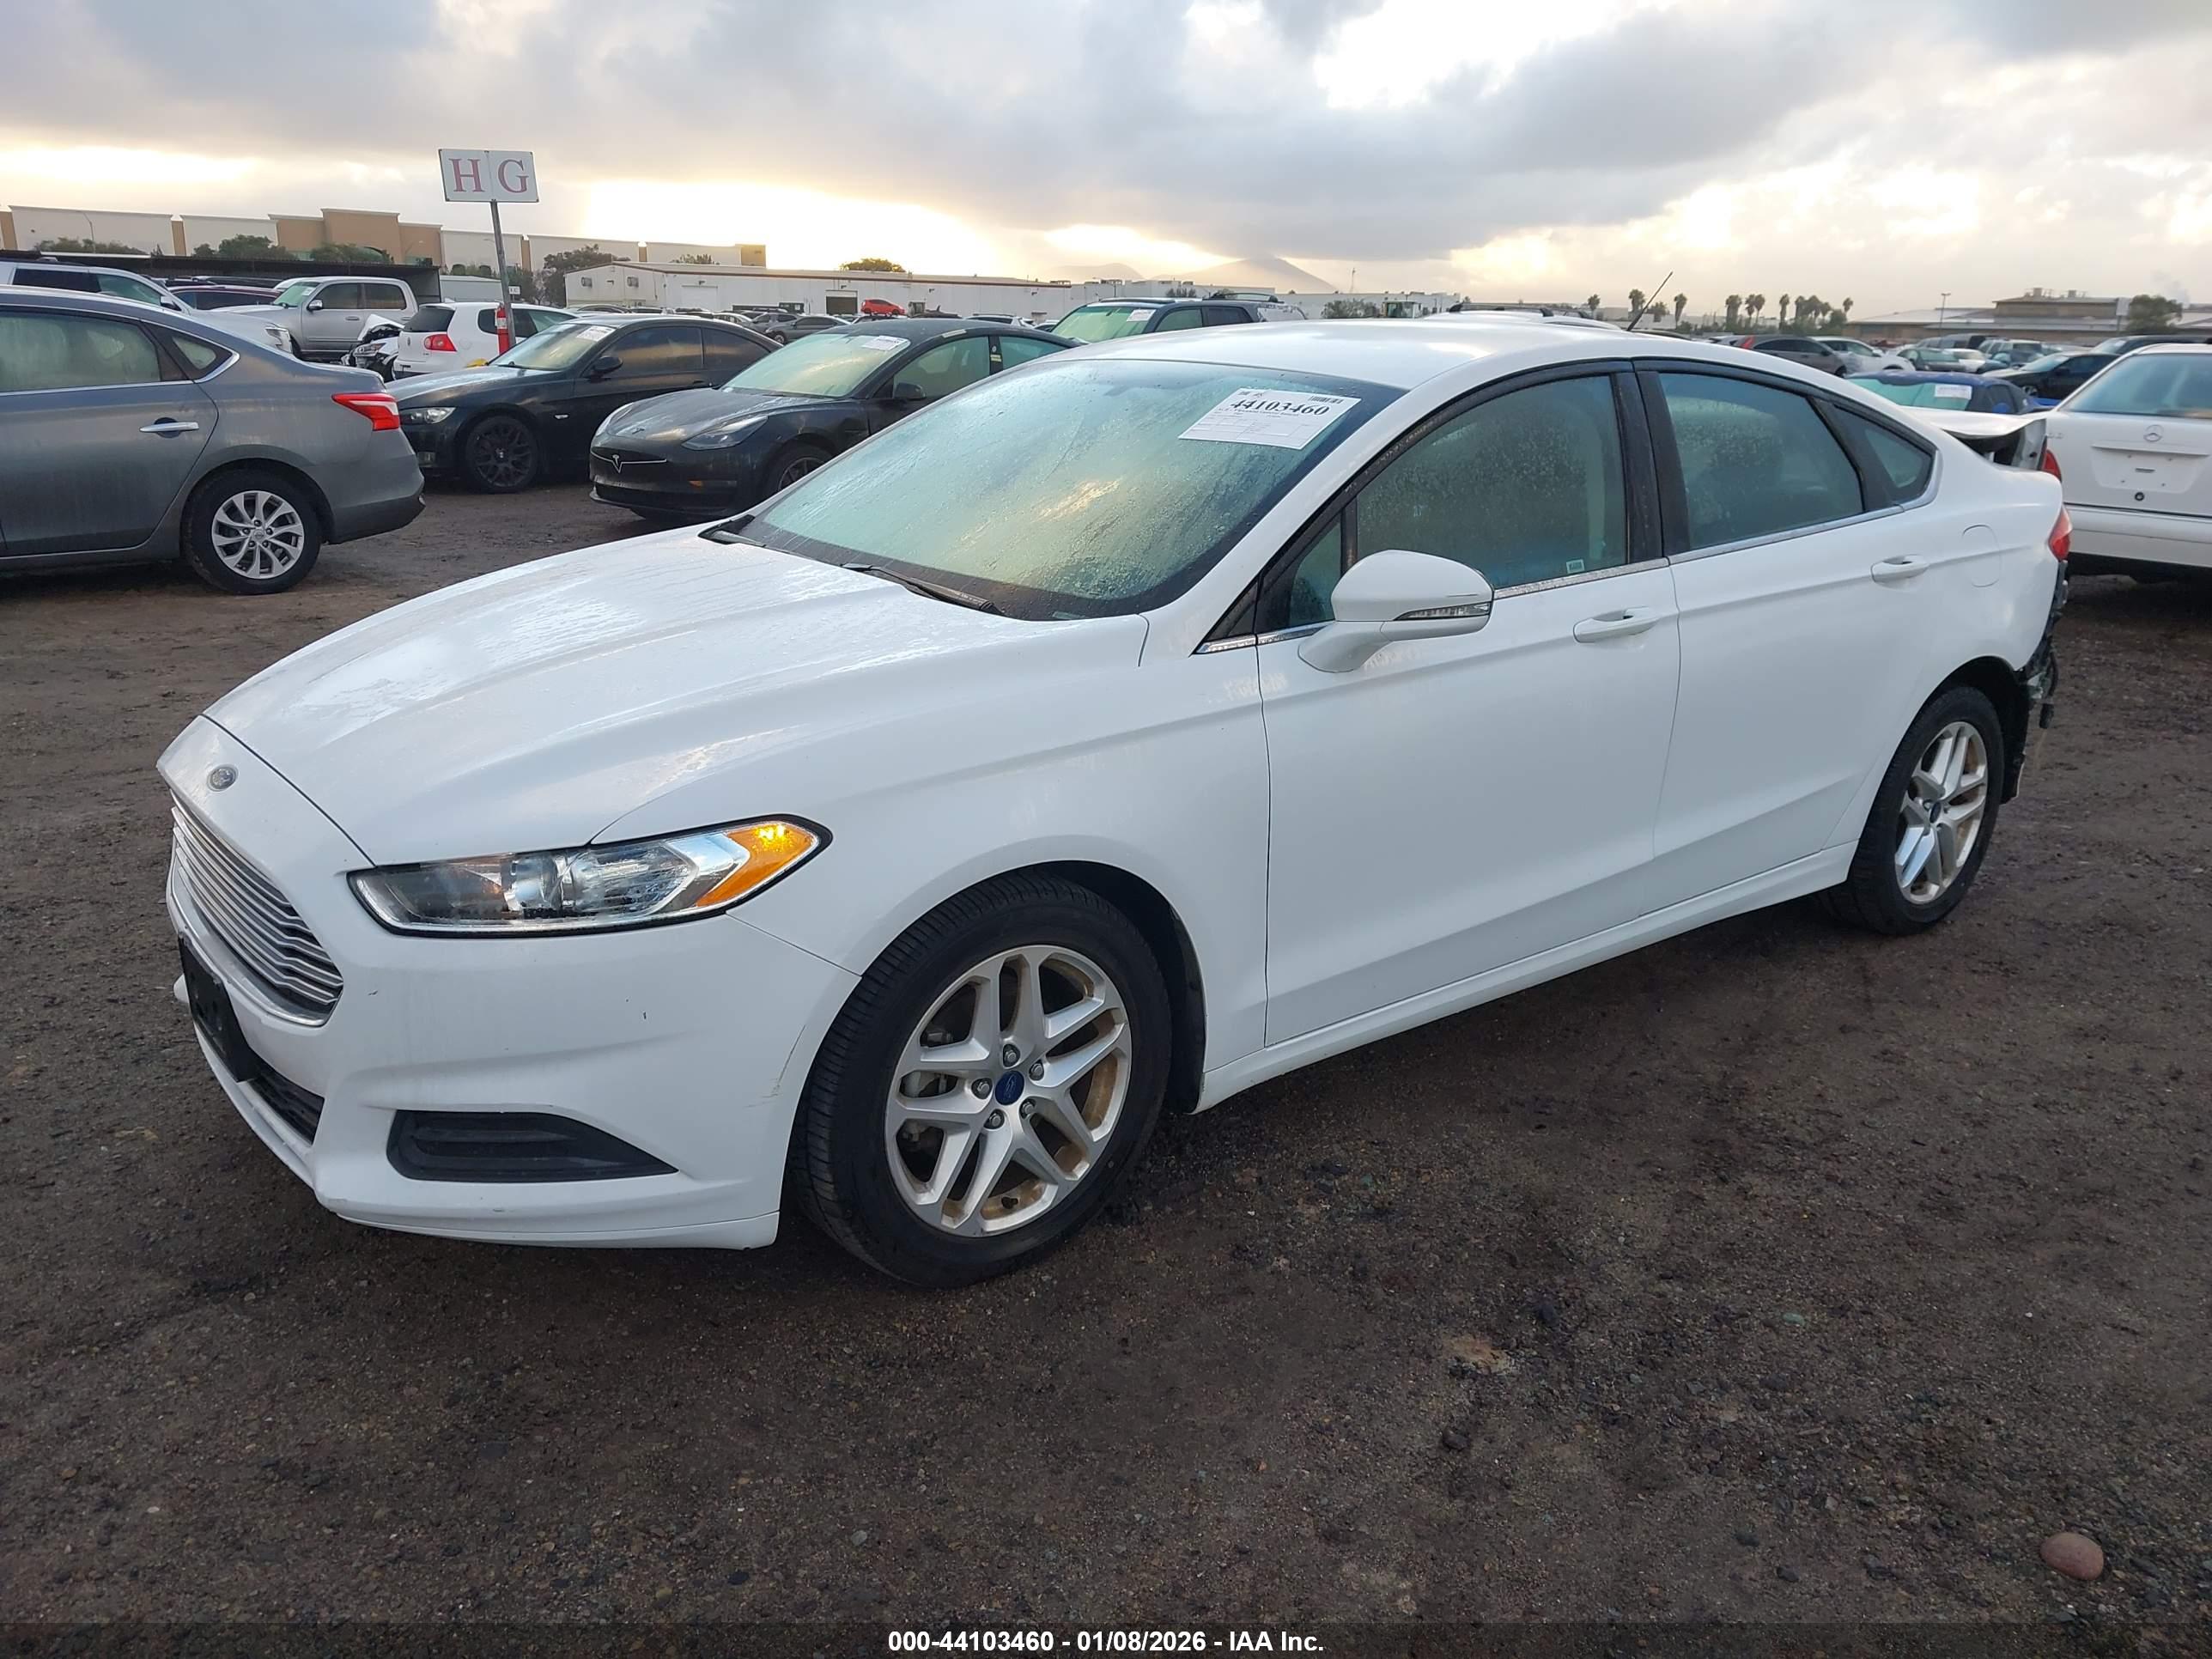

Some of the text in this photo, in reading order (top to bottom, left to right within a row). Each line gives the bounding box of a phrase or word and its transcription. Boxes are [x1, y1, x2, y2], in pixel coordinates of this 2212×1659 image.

[448, 158, 529, 193] H G
[1231, 399, 1330, 416] 44103460
